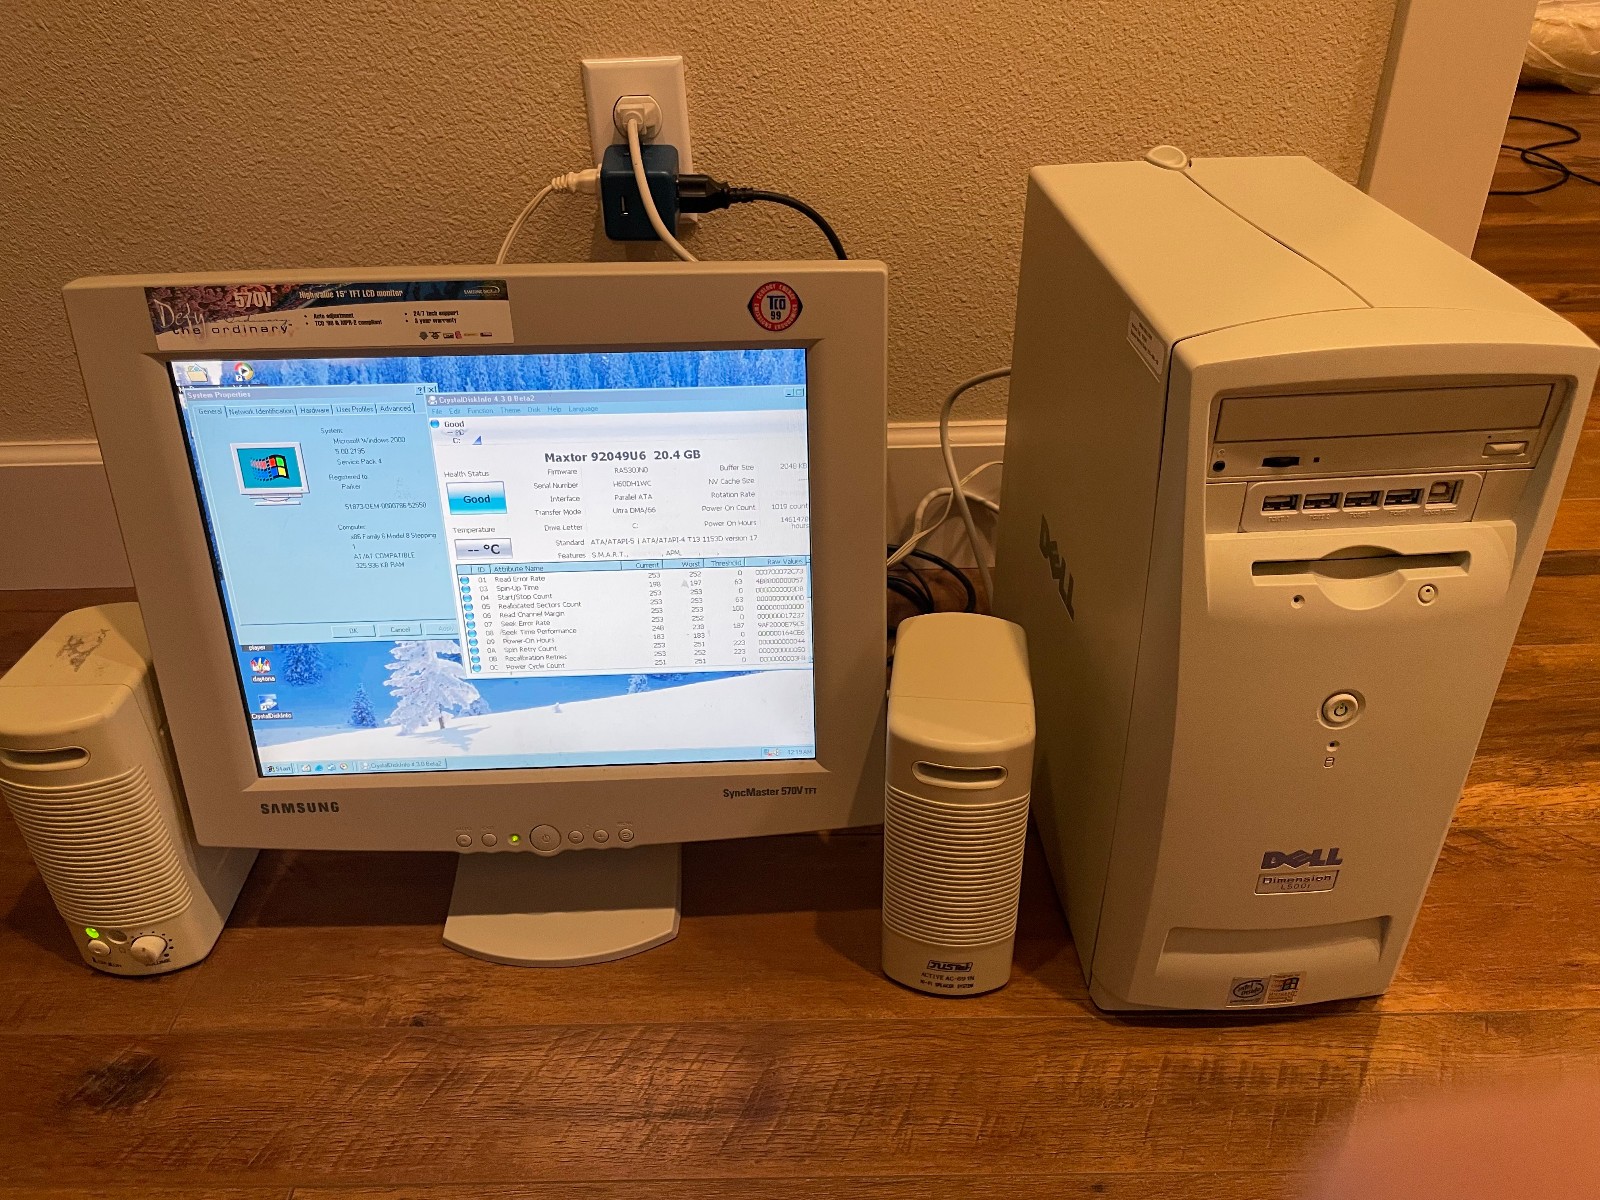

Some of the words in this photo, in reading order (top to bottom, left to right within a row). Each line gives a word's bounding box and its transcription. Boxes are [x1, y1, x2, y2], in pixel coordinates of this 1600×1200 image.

[349, 289, 360, 298] TFT
[362, 289, 375, 298] LCD
[376, 288, 403, 298] monitor
[234, 291, 272, 308] 570V
[766, 295, 786, 310] TCO
[770, 310, 781, 321] 99
[172, 325, 201, 335] the
[187, 391, 213, 400] System
[215, 390, 251, 399] Properties
[438, 396, 491, 405] CrystalDiskInfo
[514, 394, 535, 402] Beta2
[198, 407, 222, 415] General
[380, 404, 411, 412] Advanced
[547, 405, 562, 413] Help
[568, 405, 599, 413] Language
[444, 420, 465, 428] Good
[544, 452, 588, 463] Maxtor
[591, 450, 647, 462] 92049U6
[653, 450, 681, 460] 20.4
[683, 449, 701, 460] GB
[719, 464, 739, 472] Buffer
[467, 470, 490, 478] Status
[741, 477, 755, 485] Size
[463, 494, 491, 504] Good
[789, 502, 808, 510] count
[563, 508, 582, 516] Mode
[453, 526, 496, 535] Temperature
[544, 524, 561, 532] Drive
[483, 543, 501, 555] °C
[375, 551, 416, 559] COMPATIBLE
[635, 562, 659, 570] Current
[710, 559, 742, 567] Threshold
[1039, 512, 1075, 622] DELL
[390, 626, 411, 634] Cancel
[723, 787, 780, 799] SyncMaster
[781, 785, 803, 795] 570V
[804, 787, 817, 795] TFT
[260, 801, 340, 815] SAMSUNG
[1260, 847, 1344, 870] DELL
[1262, 874, 1332, 885] Dimension
[921, 971, 944, 980] ACTIVE
